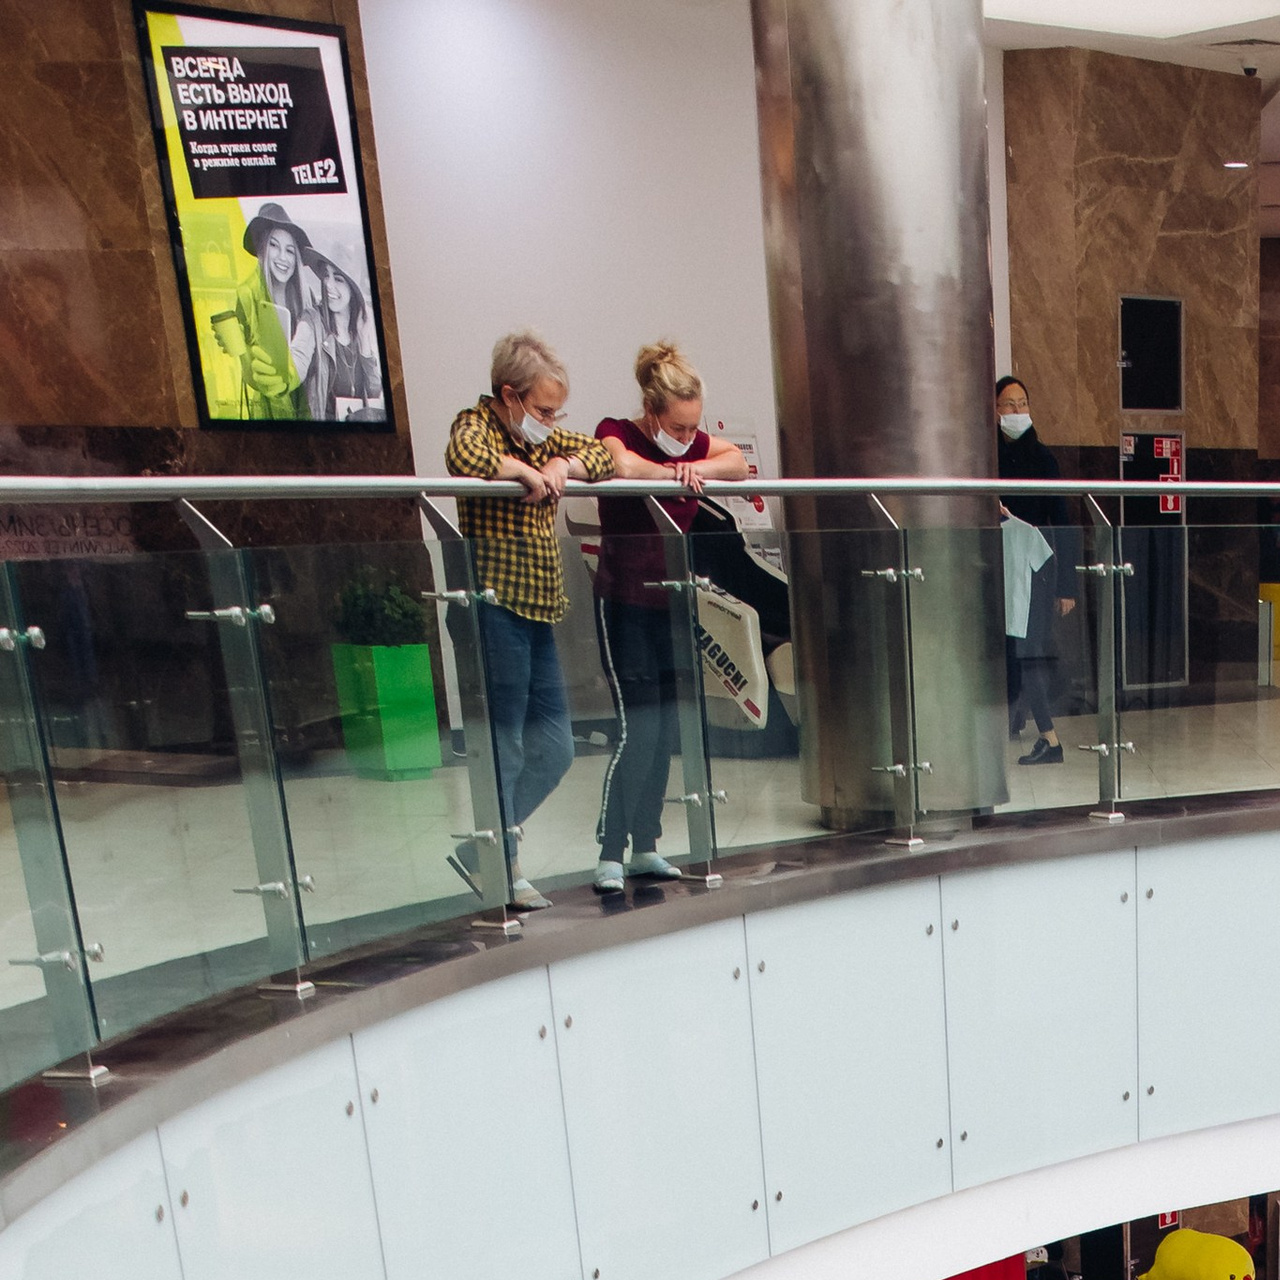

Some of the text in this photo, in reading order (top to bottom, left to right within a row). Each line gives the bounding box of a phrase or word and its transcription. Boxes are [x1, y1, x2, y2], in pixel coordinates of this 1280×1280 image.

[171, 57, 246, 82] ВСЕГДА
[177, 83, 293, 108] ЕСТЬ ВЫХОД
[182, 109, 288, 131] В ИНТЕРНЕТ
[189, 141, 277, 156] Когда нужен совет
[193, 154, 276, 171] в режиме онлайн
[291, 158, 339, 184] TELE2
